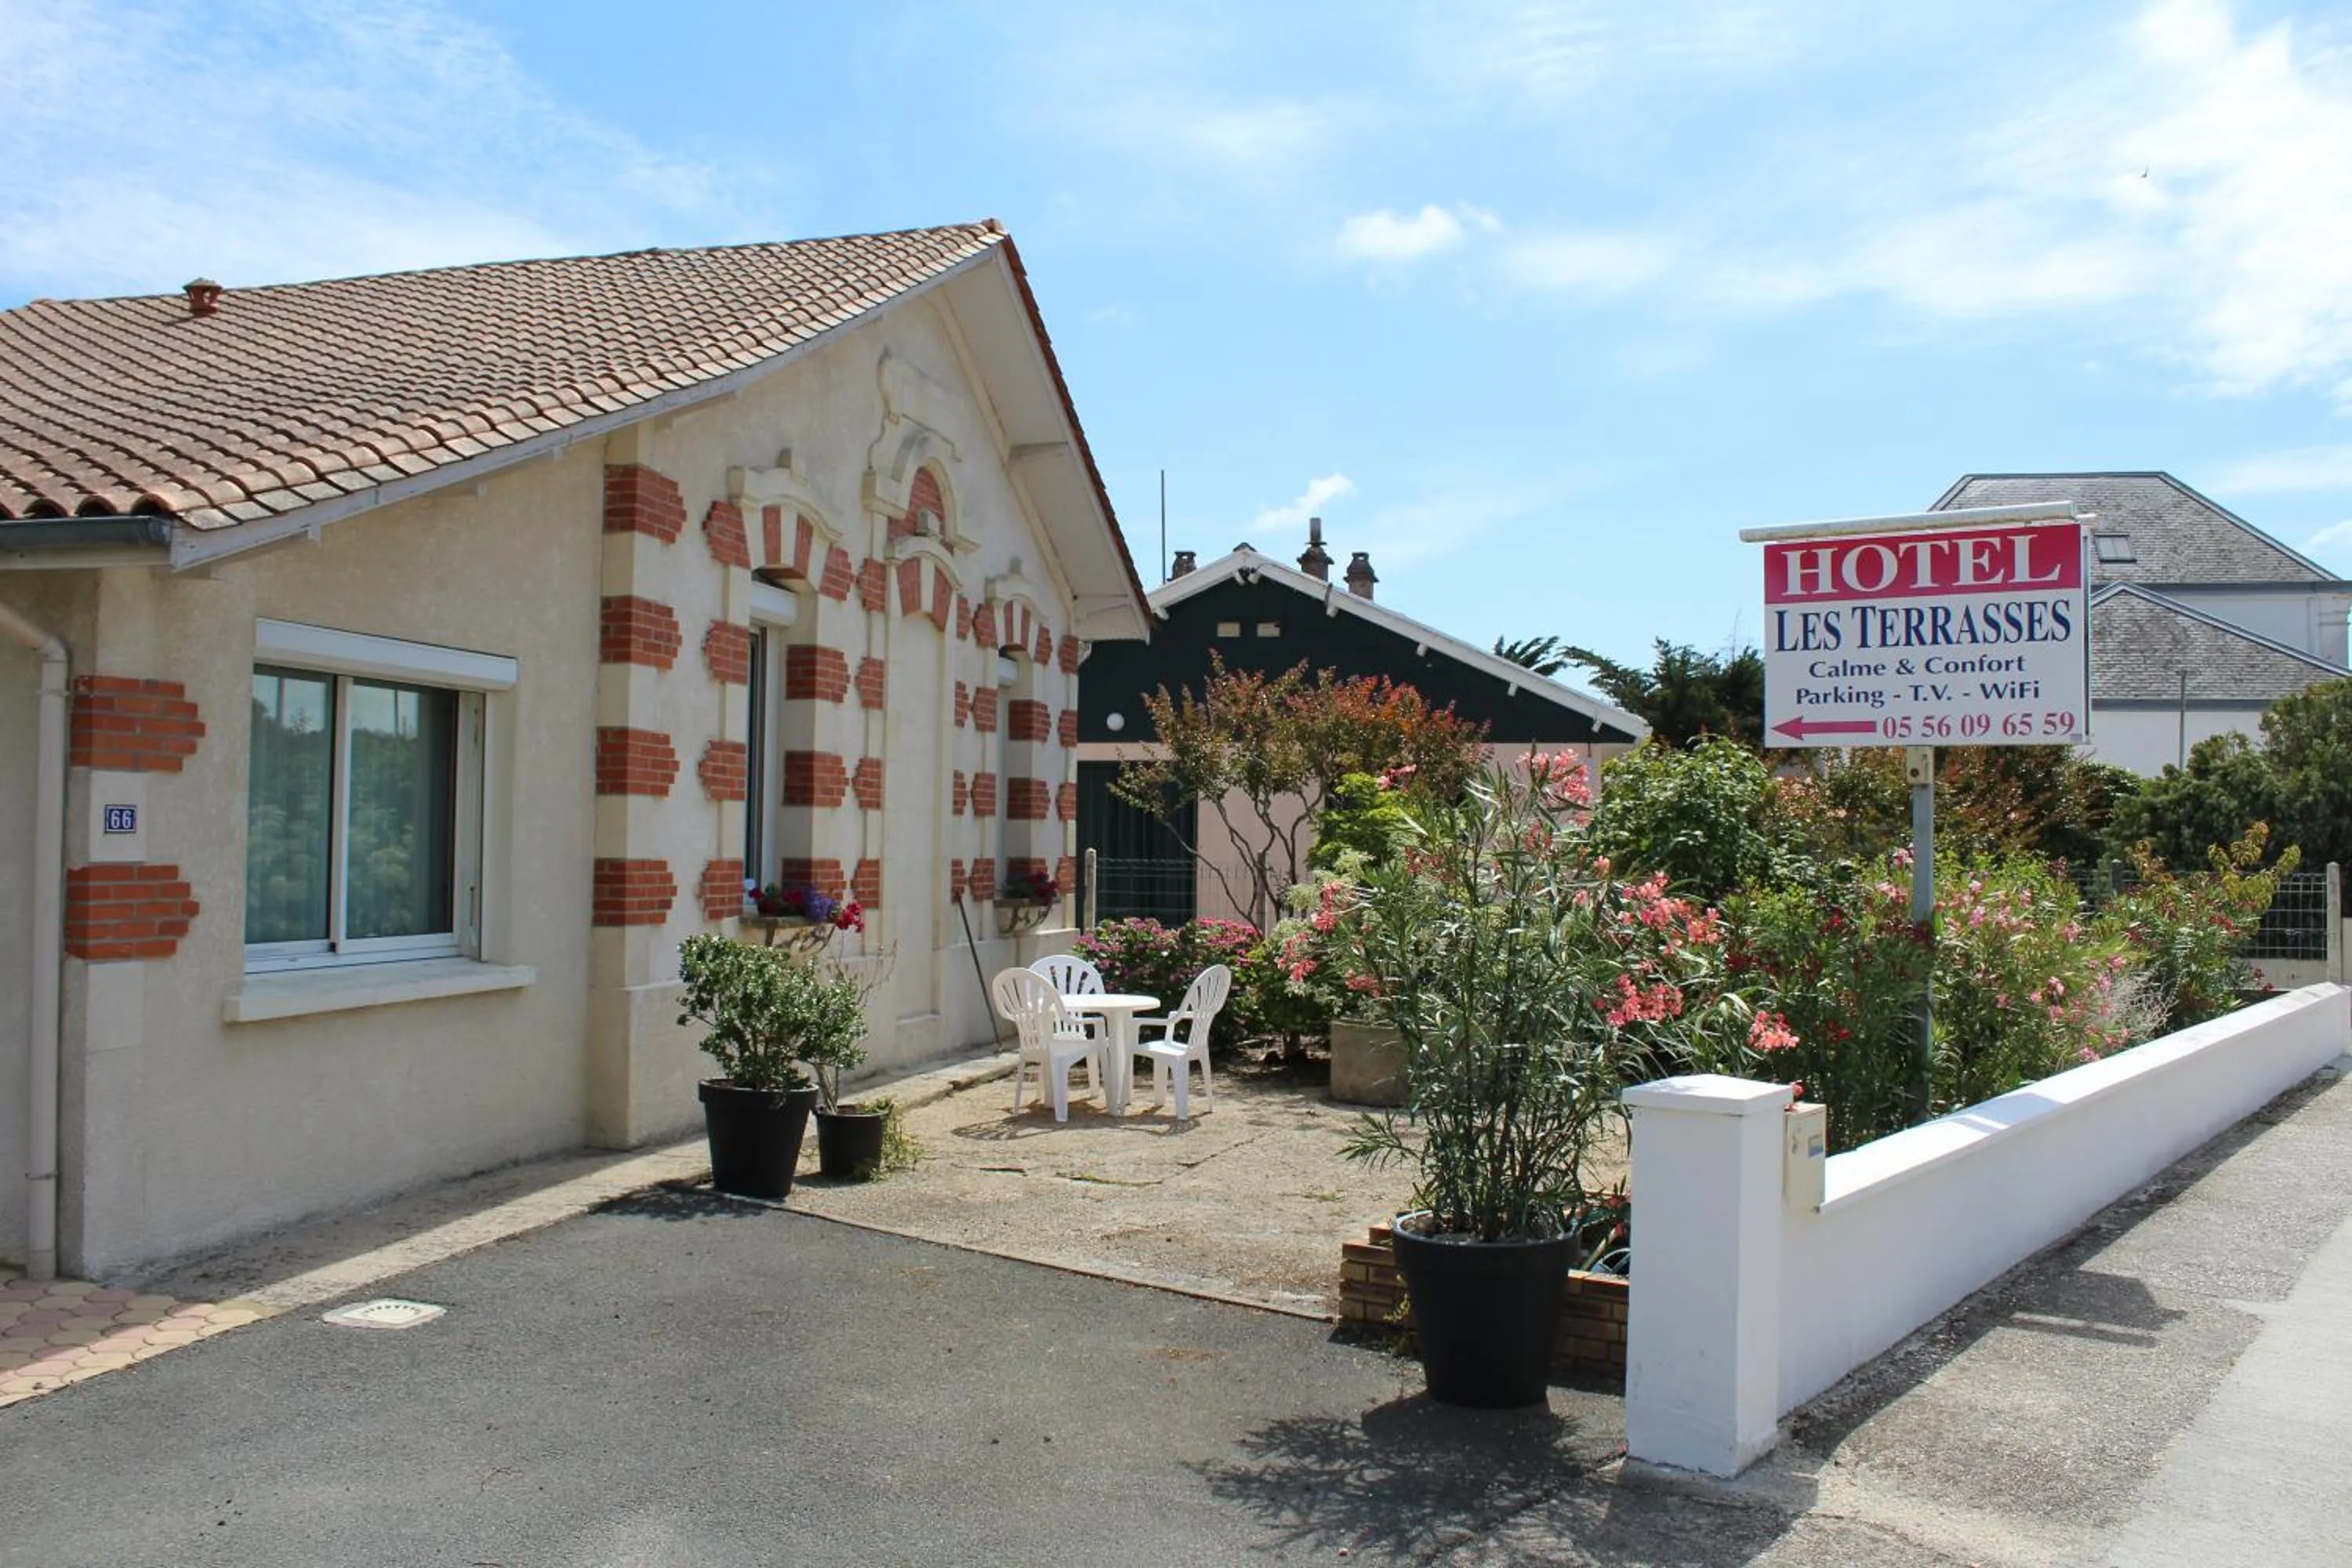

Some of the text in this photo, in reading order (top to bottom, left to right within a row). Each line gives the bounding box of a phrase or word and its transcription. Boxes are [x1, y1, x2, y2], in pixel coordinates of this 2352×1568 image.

[1780, 534, 2061, 596] HOTEL
[1774, 599, 2071, 652] LES TERRASSES
[1809, 655, 2024, 677] Calme & Confort
[1795, 687, 1884, 707] Parking
[1908, 684, 1952, 702] T.V.
[1980, 681, 2040, 699] WiFi
[1882, 711, 2075, 739] 05 56 09 65 59
[111, 810, 131, 829] 66
